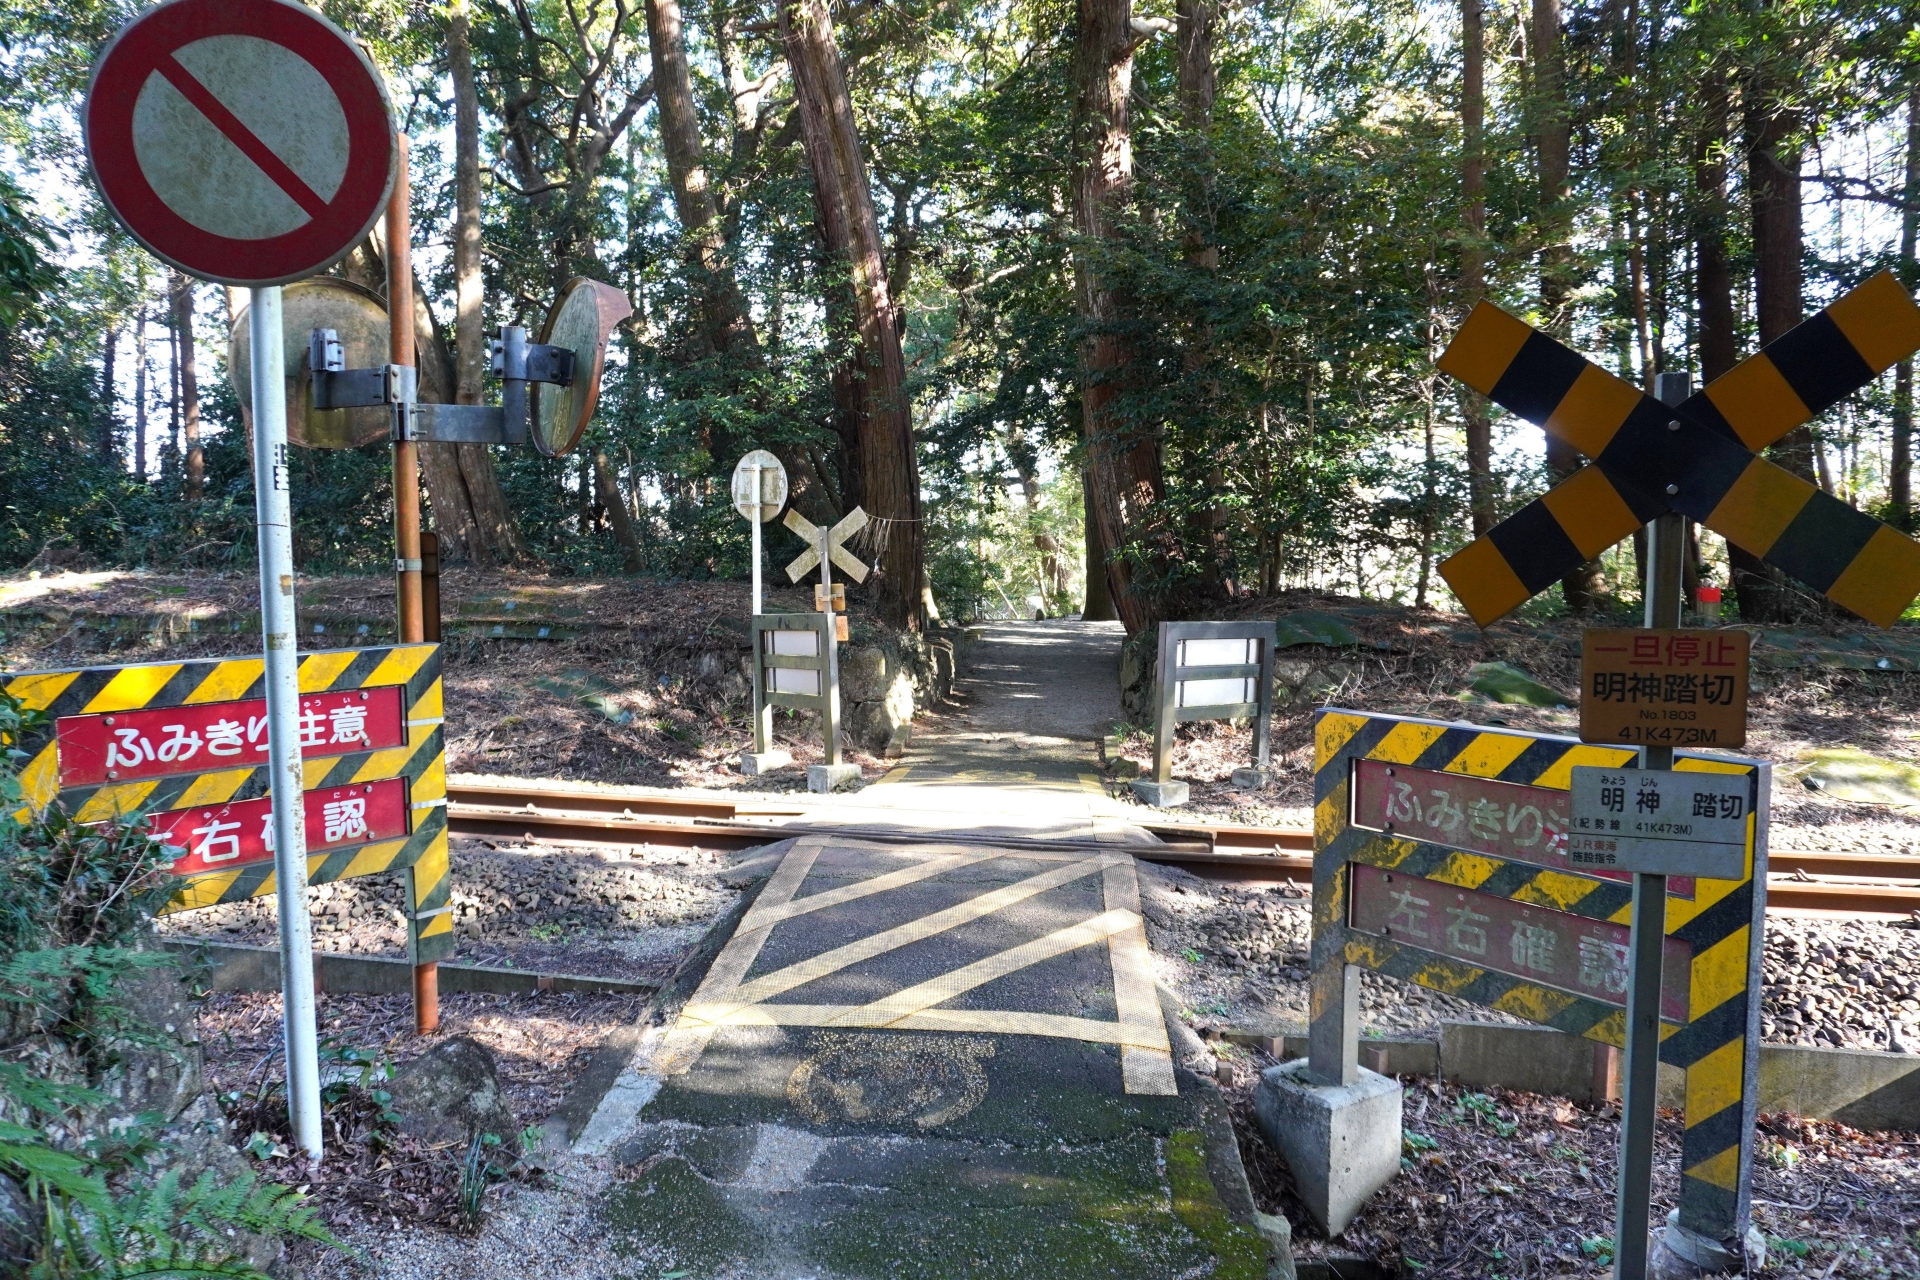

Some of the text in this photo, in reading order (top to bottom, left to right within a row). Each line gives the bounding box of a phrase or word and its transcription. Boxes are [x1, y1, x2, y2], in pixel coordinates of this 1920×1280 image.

[1594, 635, 1736, 667] 一旦停止
[1593, 672, 1735, 706] 明神踏切
[1639, 709, 1697, 721] No.1803
[1618, 726, 1718, 743] 41K473M
[1601, 775, 1658, 787] みょう じん
[1573, 839, 1617, 851] JR東海
[1572, 851, 1616, 865] 施設指令
